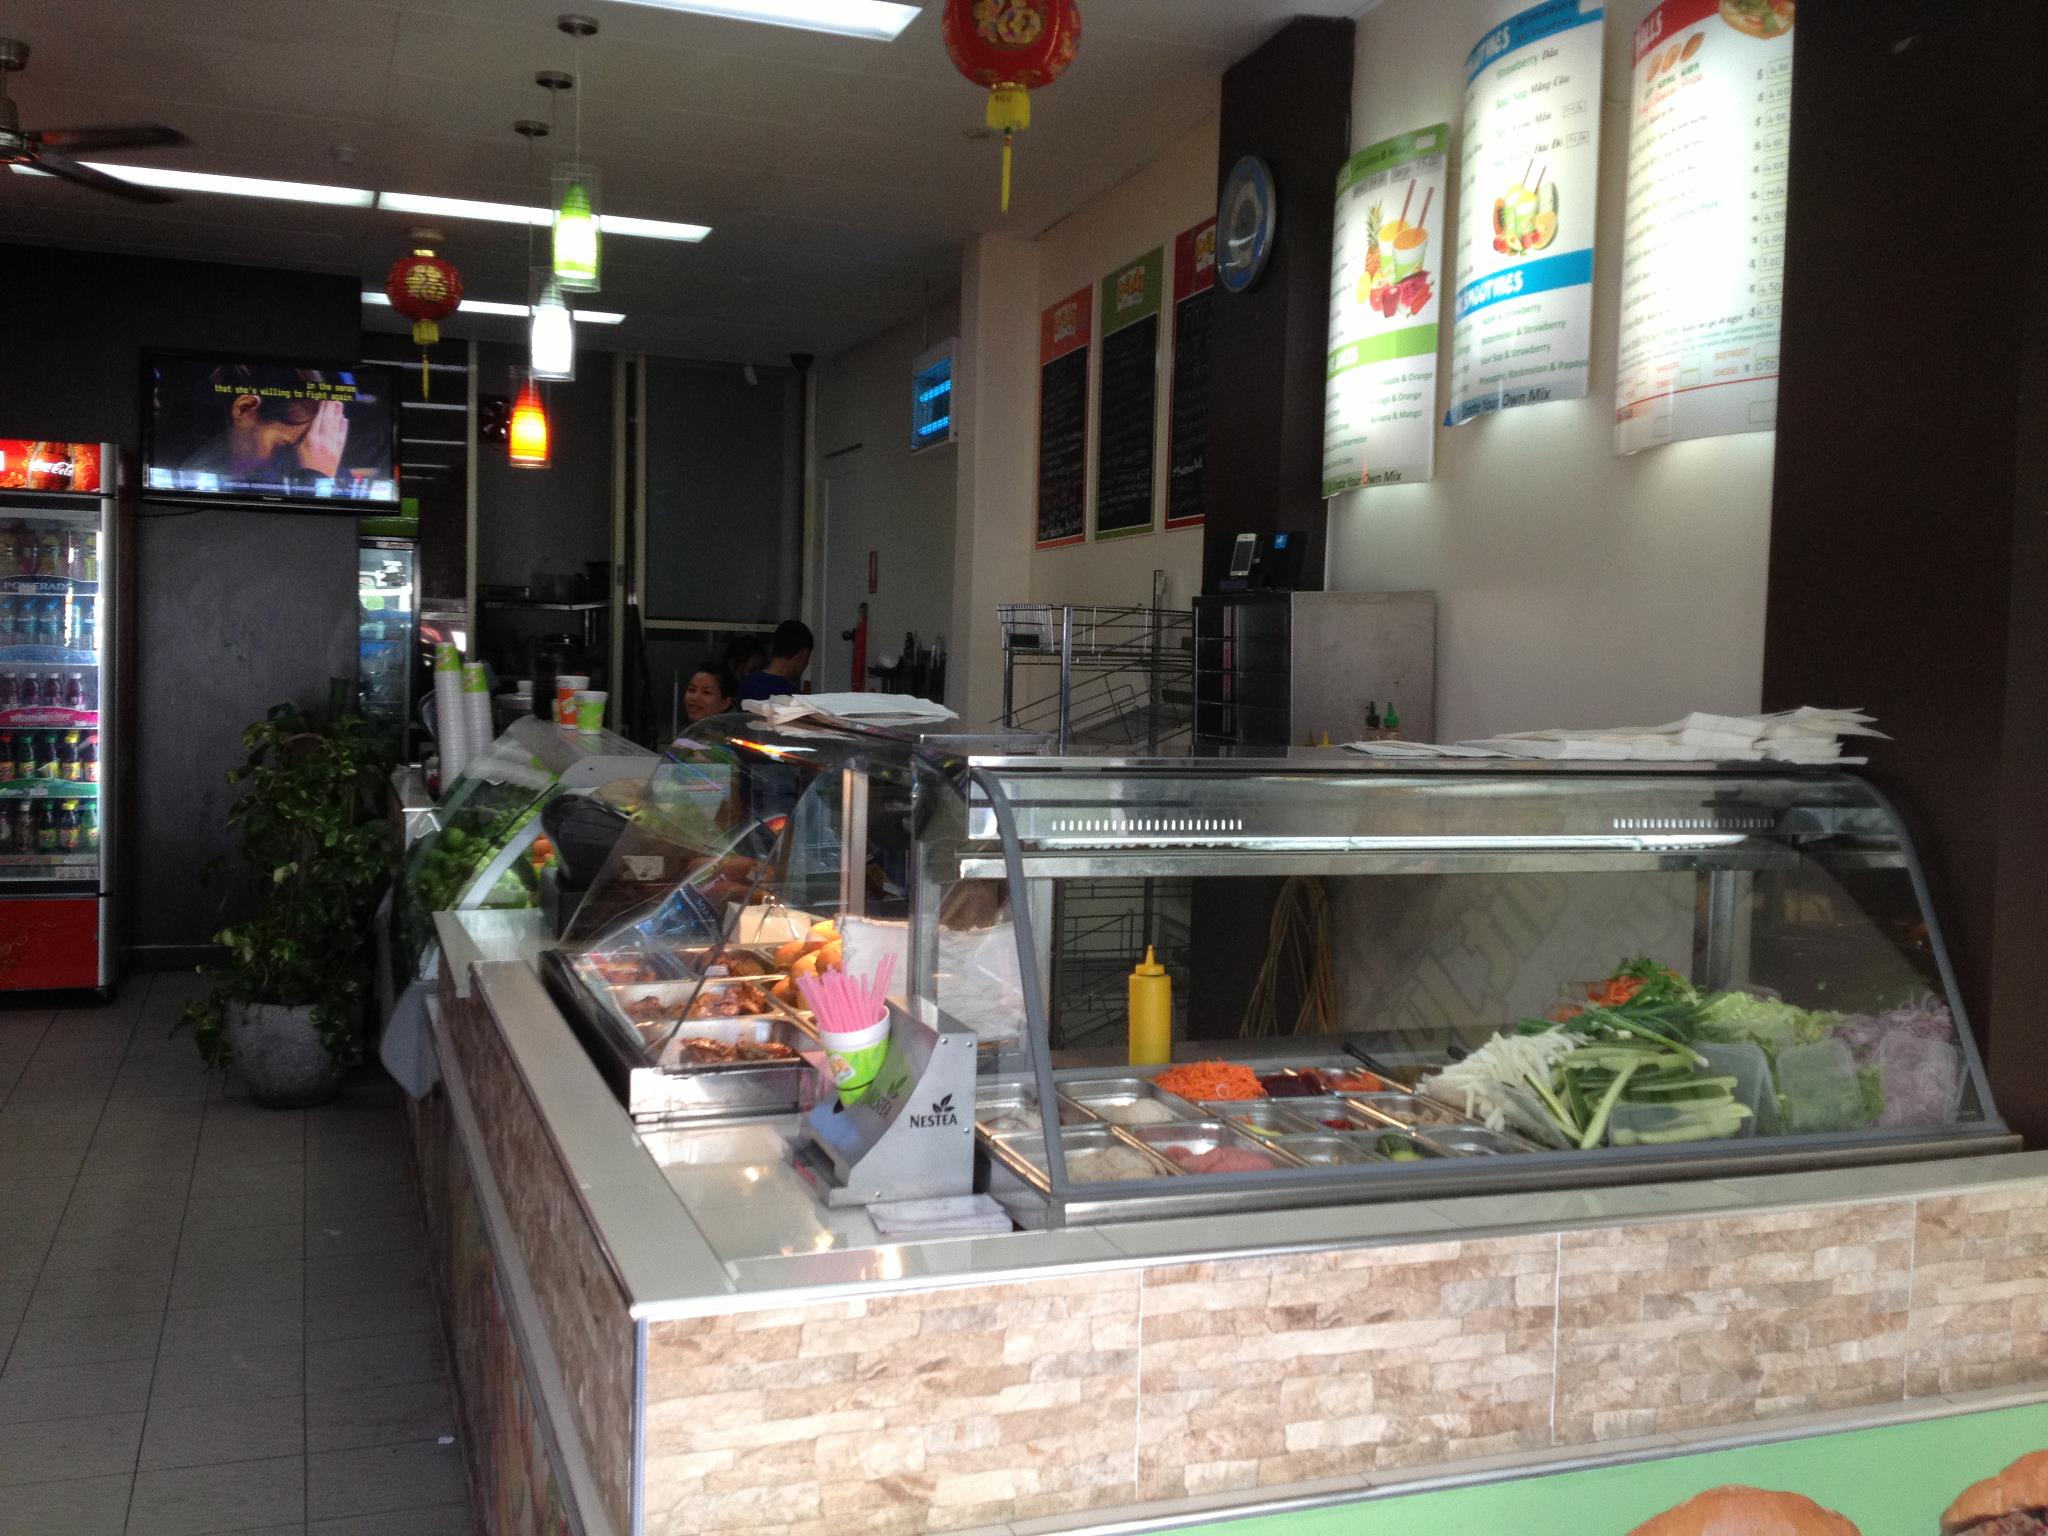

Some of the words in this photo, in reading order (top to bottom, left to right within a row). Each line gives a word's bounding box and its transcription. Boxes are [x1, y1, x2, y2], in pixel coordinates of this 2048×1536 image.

[1523, 319, 1567, 335] Strawberry
[1511, 343, 1551, 358] Strawberry
[1408, 371, 1434, 382] Orange
[214, 384, 232, 393] that
[235, 384, 257, 395] she's
[260, 387, 291, 399] willing
[294, 389, 303, 399] to
[1398, 391, 1423, 402] Orange
[1502, 392, 1526, 407] Own
[1528, 386, 1552, 402] Mix
[1383, 469, 1402, 482] Mix
[909, 1113, 958, 1129] NESTEA
